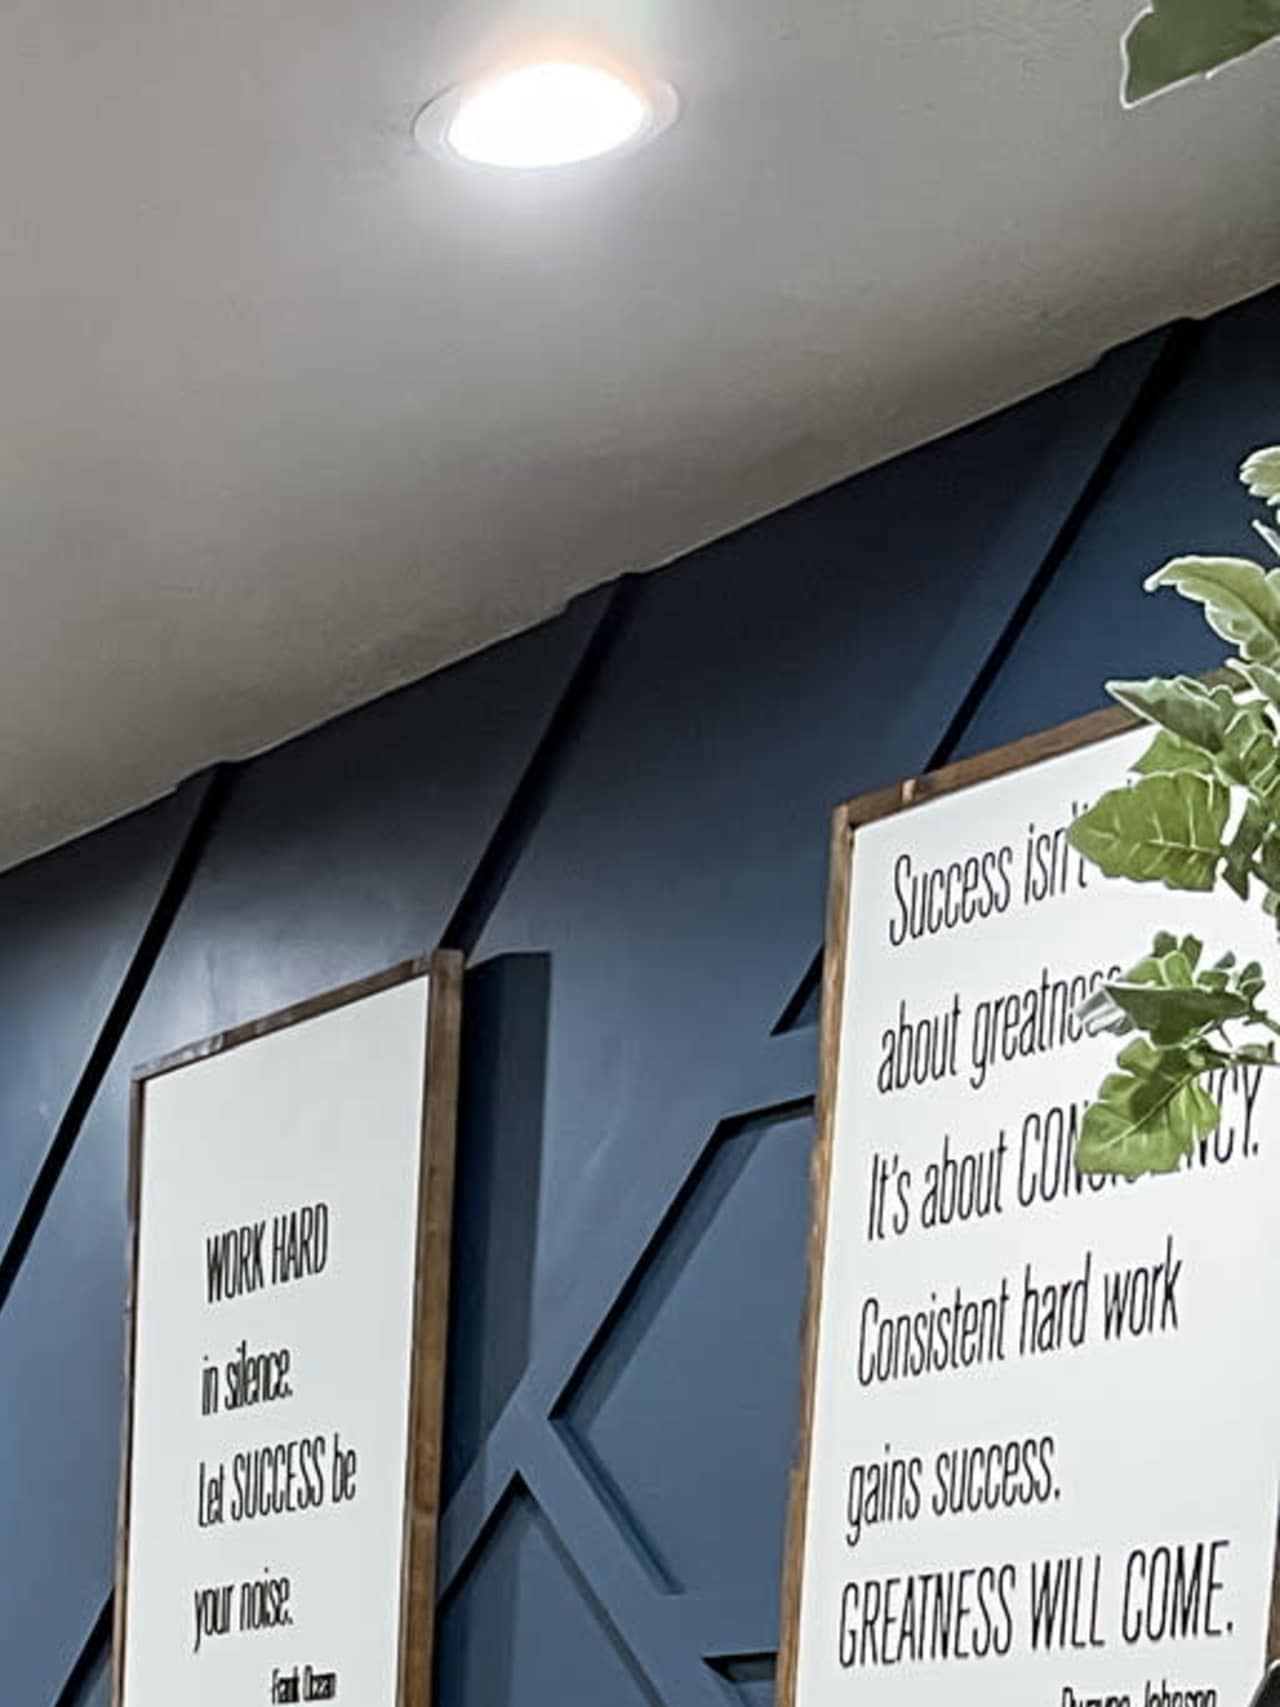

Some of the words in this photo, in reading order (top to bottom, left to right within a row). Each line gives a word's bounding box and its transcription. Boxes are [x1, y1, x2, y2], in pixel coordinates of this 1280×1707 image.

[889, 846, 1013, 947] Success
[877, 993, 961, 1095] about
[868, 1153, 911, 1241] It's
[921, 1130, 1008, 1229] about
[206, 1220, 267, 1304] WORK
[271, 1202, 329, 1286] HARD
[857, 1278, 1010, 1387] Consistent
[1019, 1251, 1092, 1356] hard
[1104, 1235, 1183, 1341] work
[224, 1339, 294, 1411] silence.
[197, 1461, 225, 1528] Let
[230, 1435, 326, 1522] SUCCESS
[331, 1432, 357, 1504] be
[846, 1443, 923, 1548] gains
[931, 1436, 1061, 1517] success.
[193, 1584, 235, 1654] your
[239, 1567, 294, 1631] noise.
[839, 1563, 1016, 1669] GREATNESS
[1031, 1554, 1105, 1651] WILL
[1121, 1539, 1234, 1645] COME.
